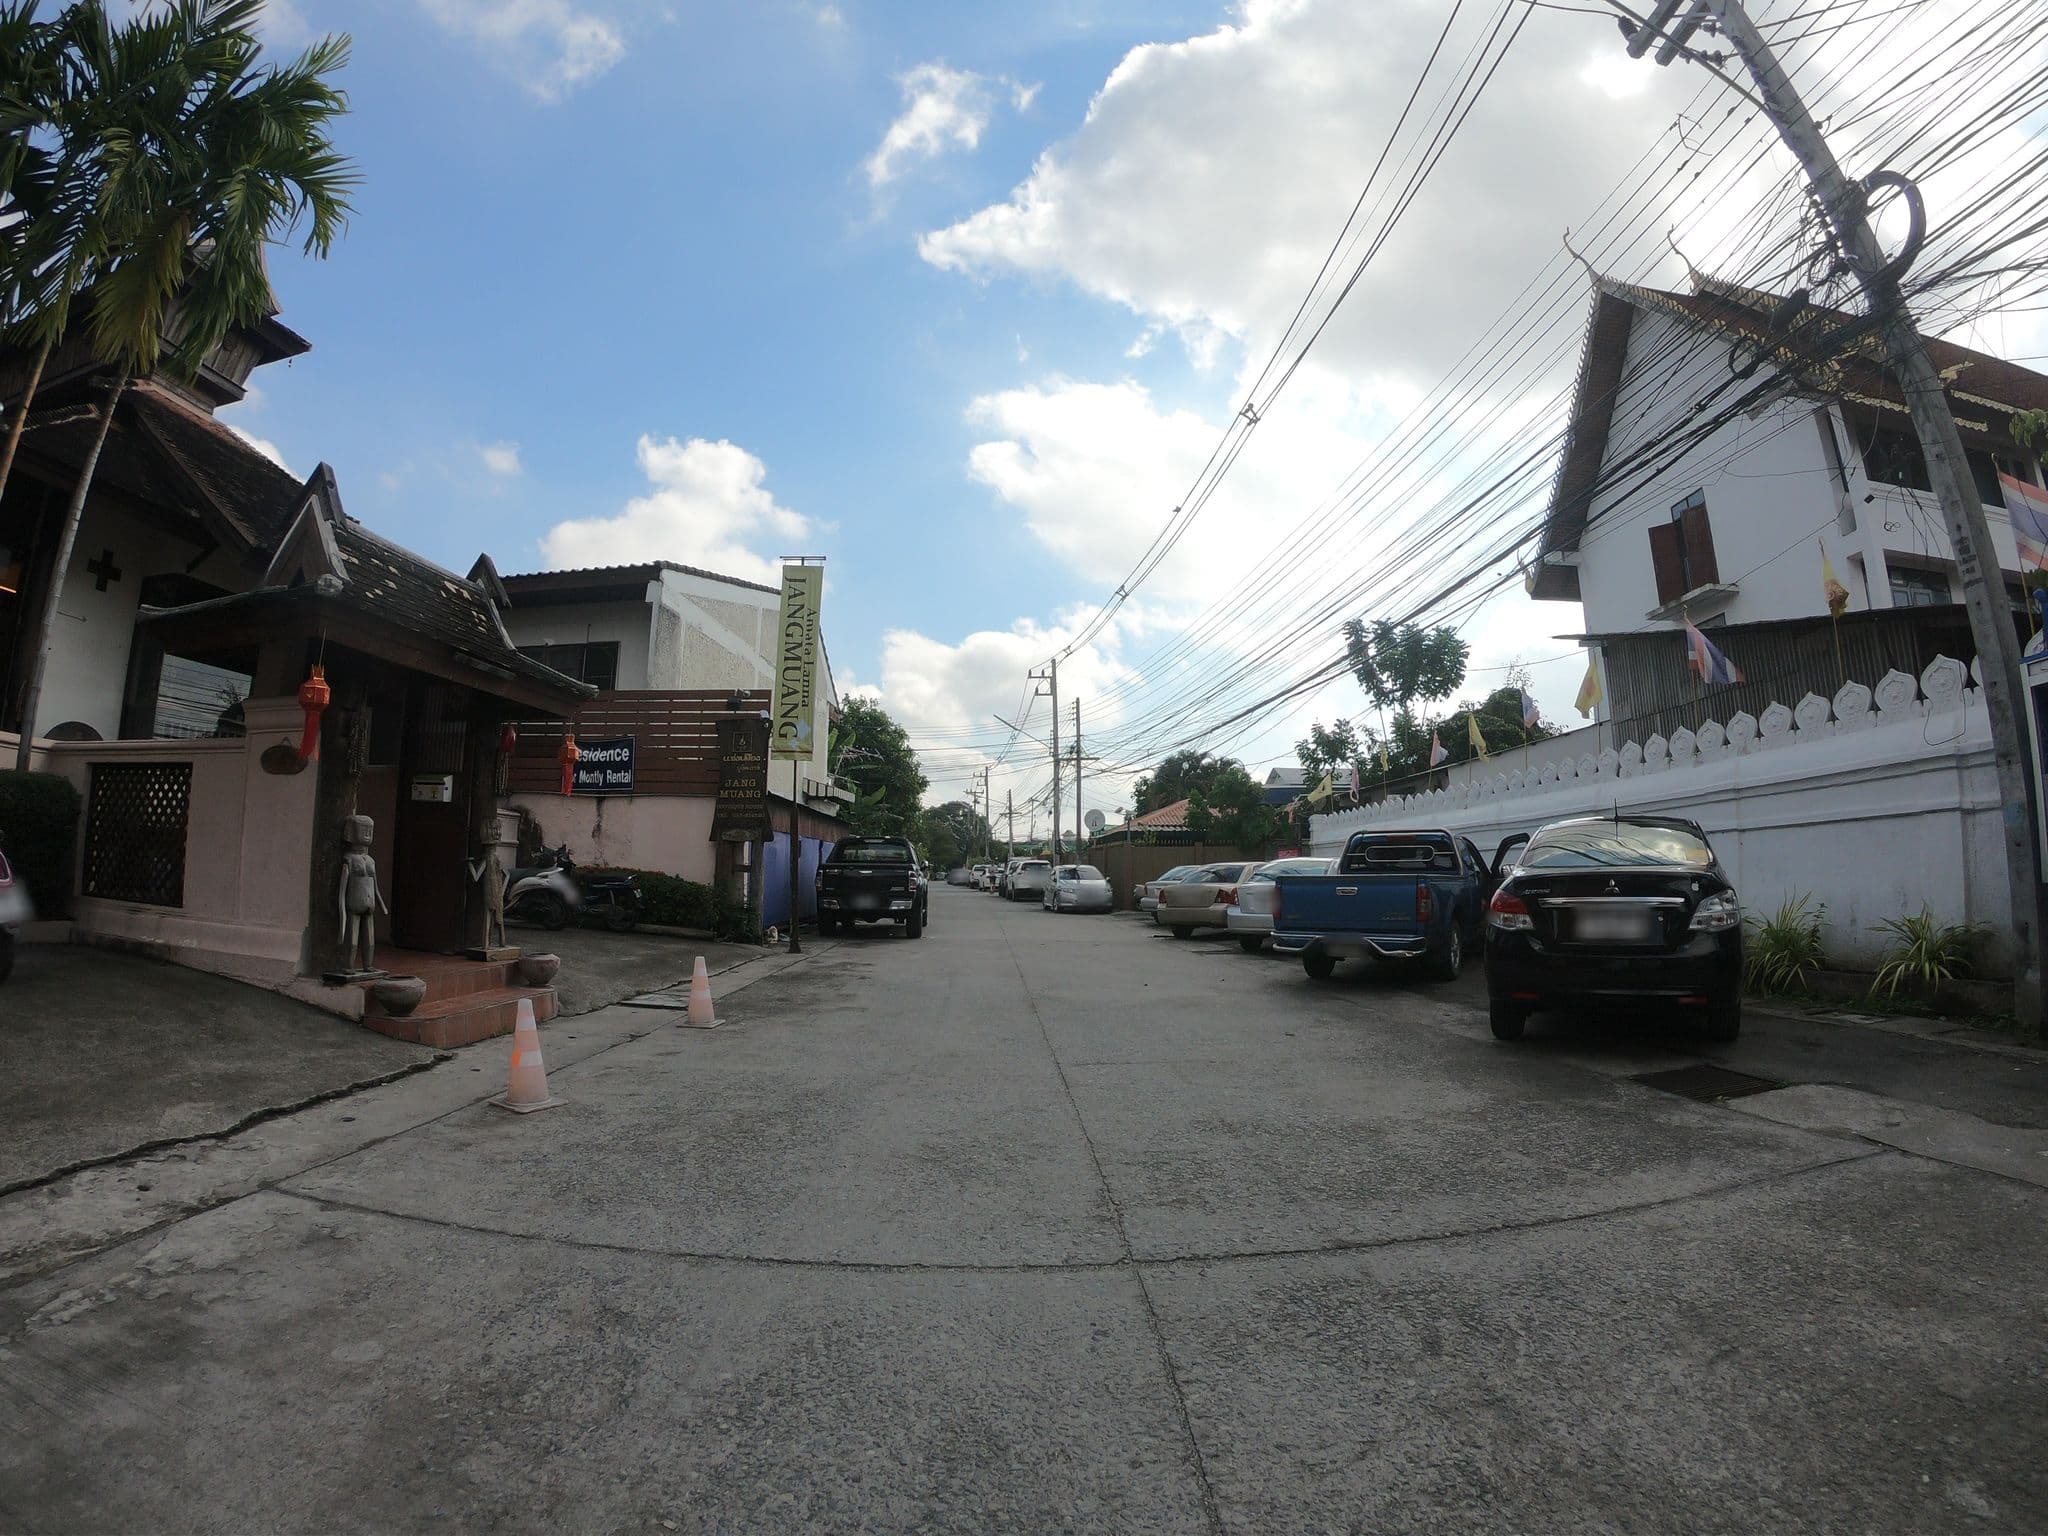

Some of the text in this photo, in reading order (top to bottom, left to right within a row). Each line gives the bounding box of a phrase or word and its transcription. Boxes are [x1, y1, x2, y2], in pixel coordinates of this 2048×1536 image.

[777, 575, 808, 740] JANGMUANG
[801, 660, 815, 709] Lanna
[607, 770, 631, 783] Rental
[725, 779, 756, 787] JANG
[720, 790, 761, 798] MUANG
